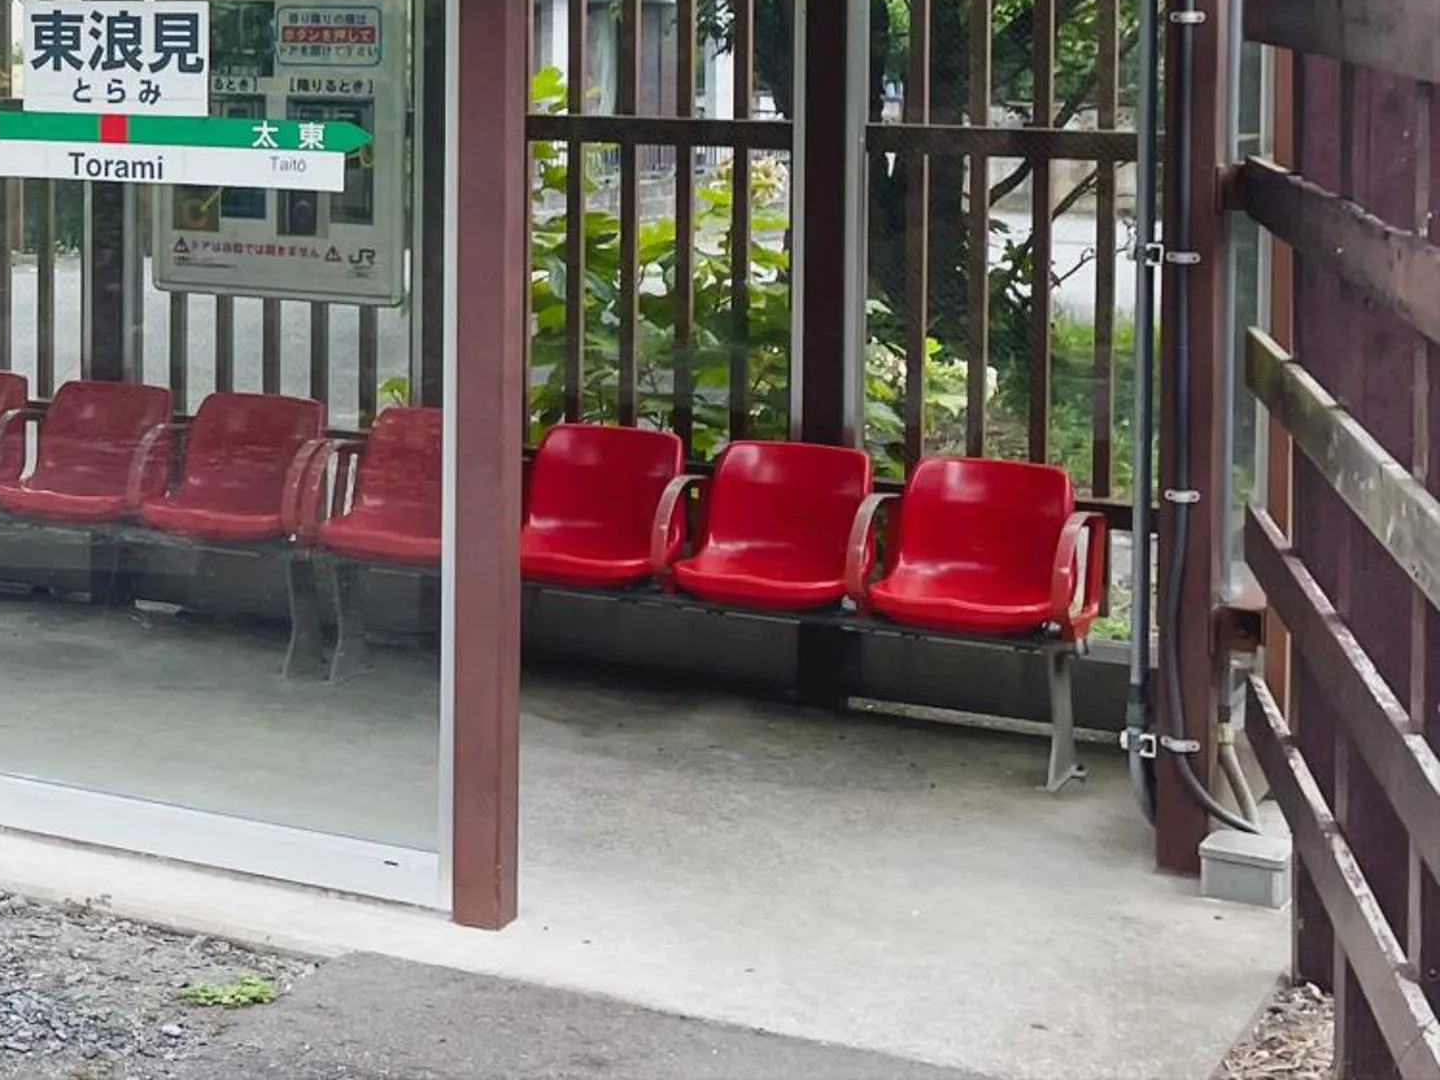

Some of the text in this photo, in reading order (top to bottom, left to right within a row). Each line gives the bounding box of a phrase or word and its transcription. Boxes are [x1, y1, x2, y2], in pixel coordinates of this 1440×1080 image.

[30, 9, 206, 74] 東浪見
[72, 76, 162, 105] とらみ
[251, 119, 326, 150] 太東
[67, 151, 164, 180] Torami
[347, 247, 376, 266] JR
